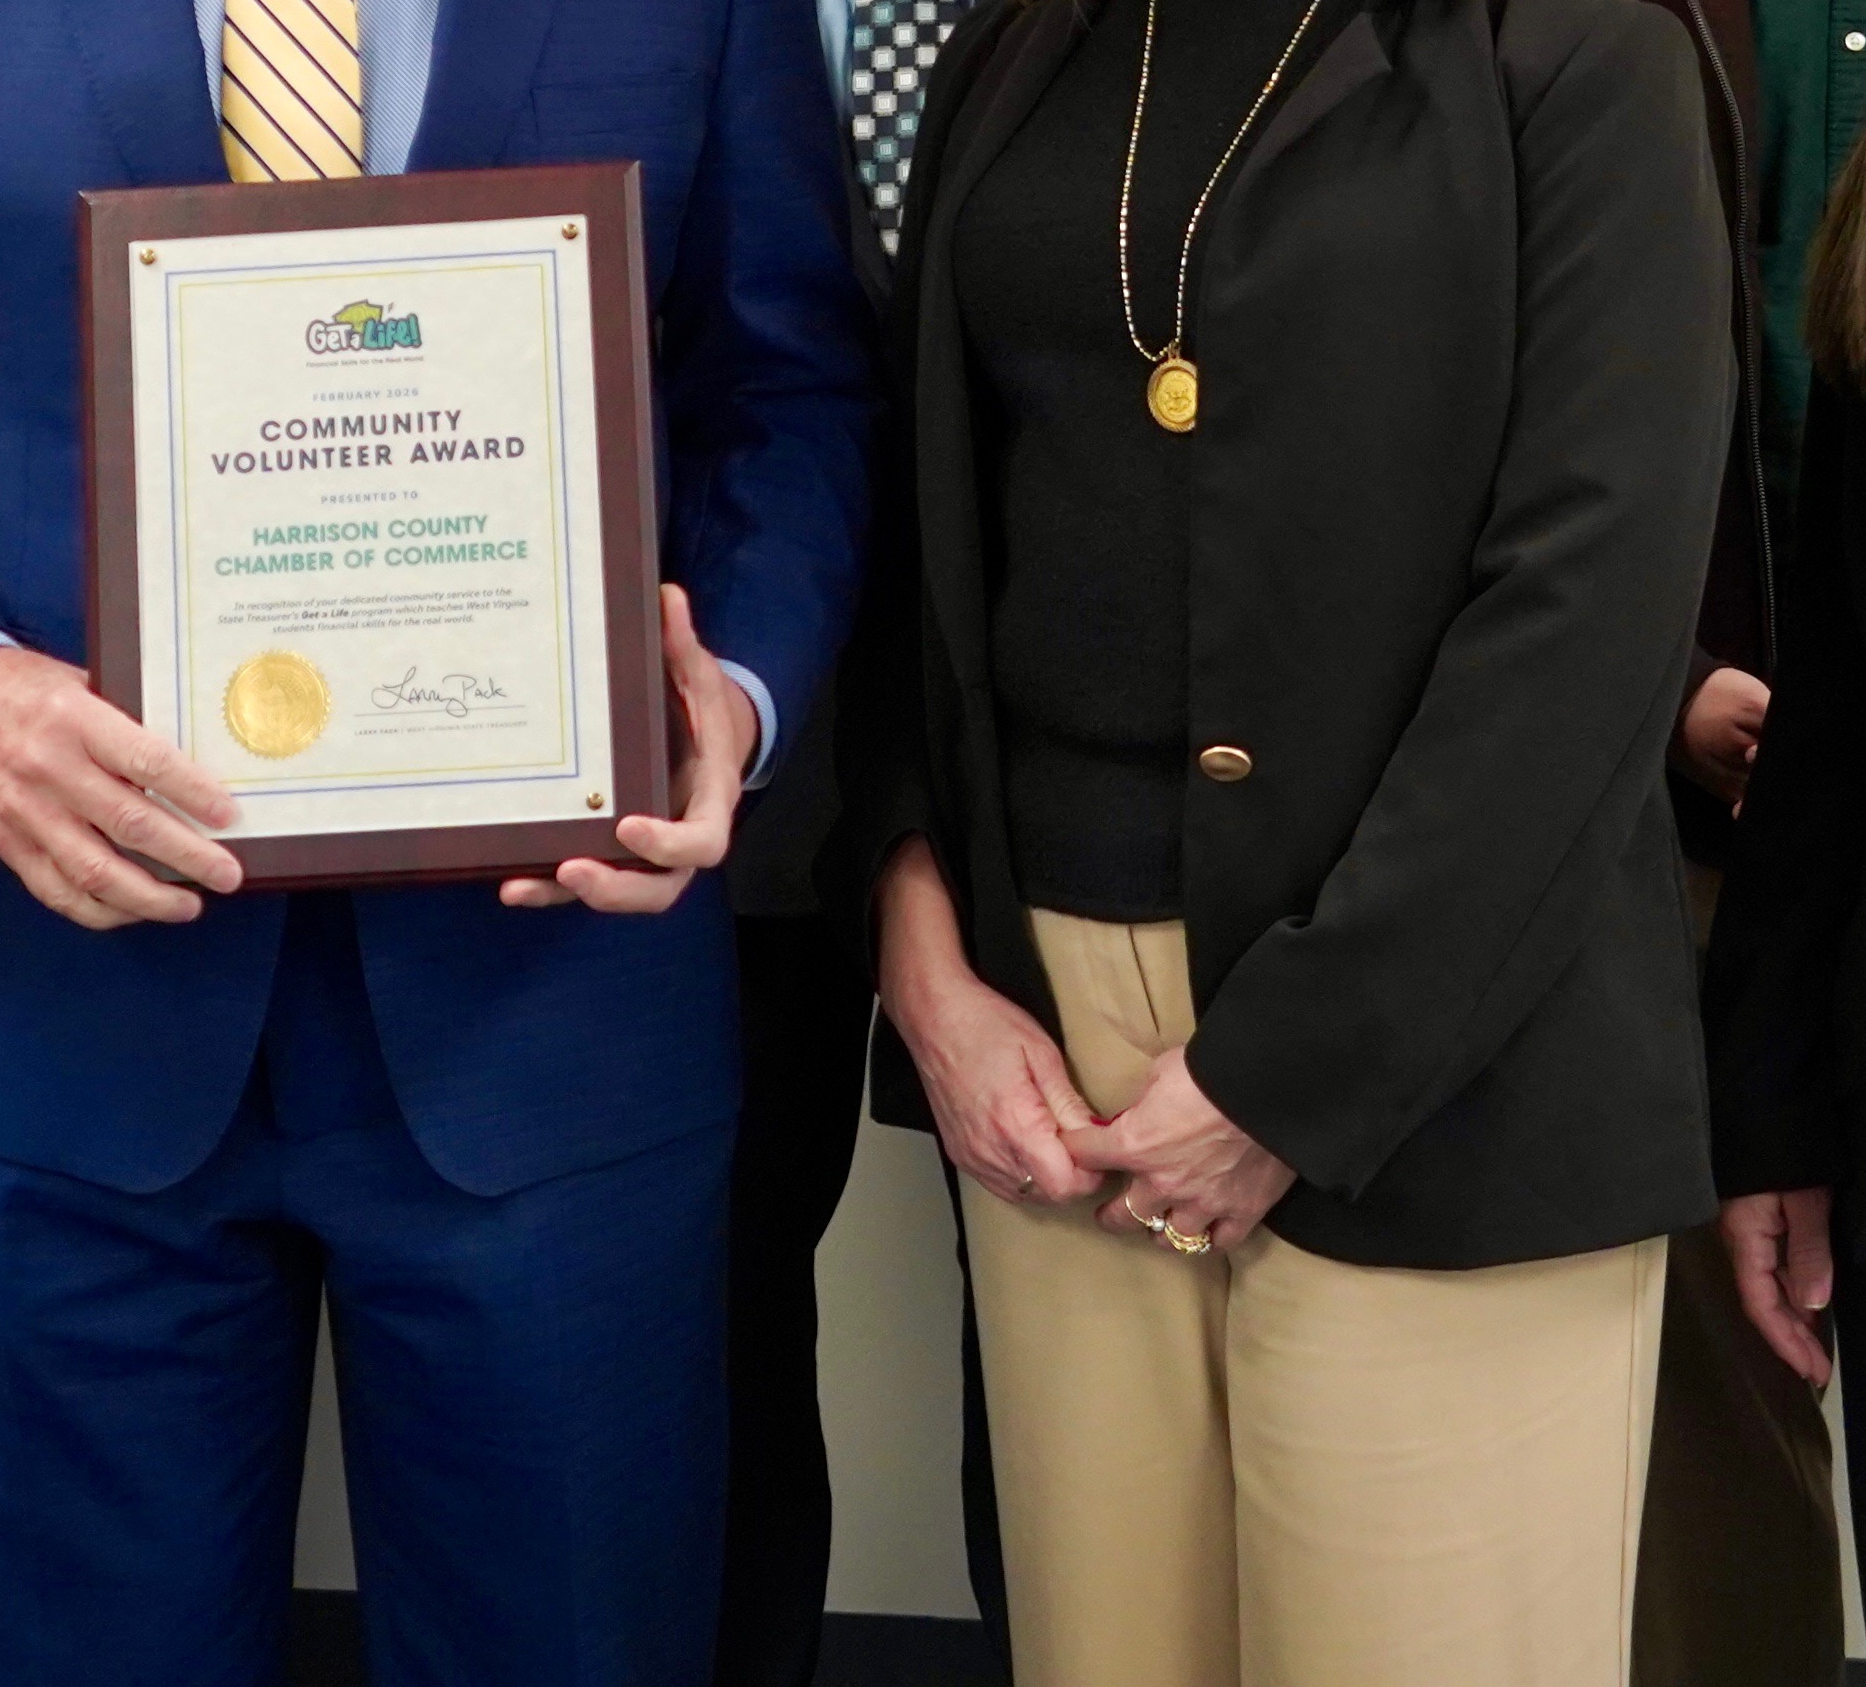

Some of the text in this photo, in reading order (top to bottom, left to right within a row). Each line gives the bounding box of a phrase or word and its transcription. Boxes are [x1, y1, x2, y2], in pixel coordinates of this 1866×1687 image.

[312, 388, 419, 402] FEBRUARY 2026
[259, 409, 462, 442] COMMUNITY
[211, 436, 525, 475] VOLUNTEER AWARD
[321, 490, 419, 505] PRESENTED TO
[252, 514, 489, 546] HARRISON COUNTY
[214, 540, 528, 577] CHAMBER OF COMMERCE
[218, 598, 530, 625] State Treasurer's Get a Life program which teaches West Virginia
[234, 586, 513, 611] In recognition of your dedicated community service to the
[272, 614, 474, 634] students financial skills for the real world.
